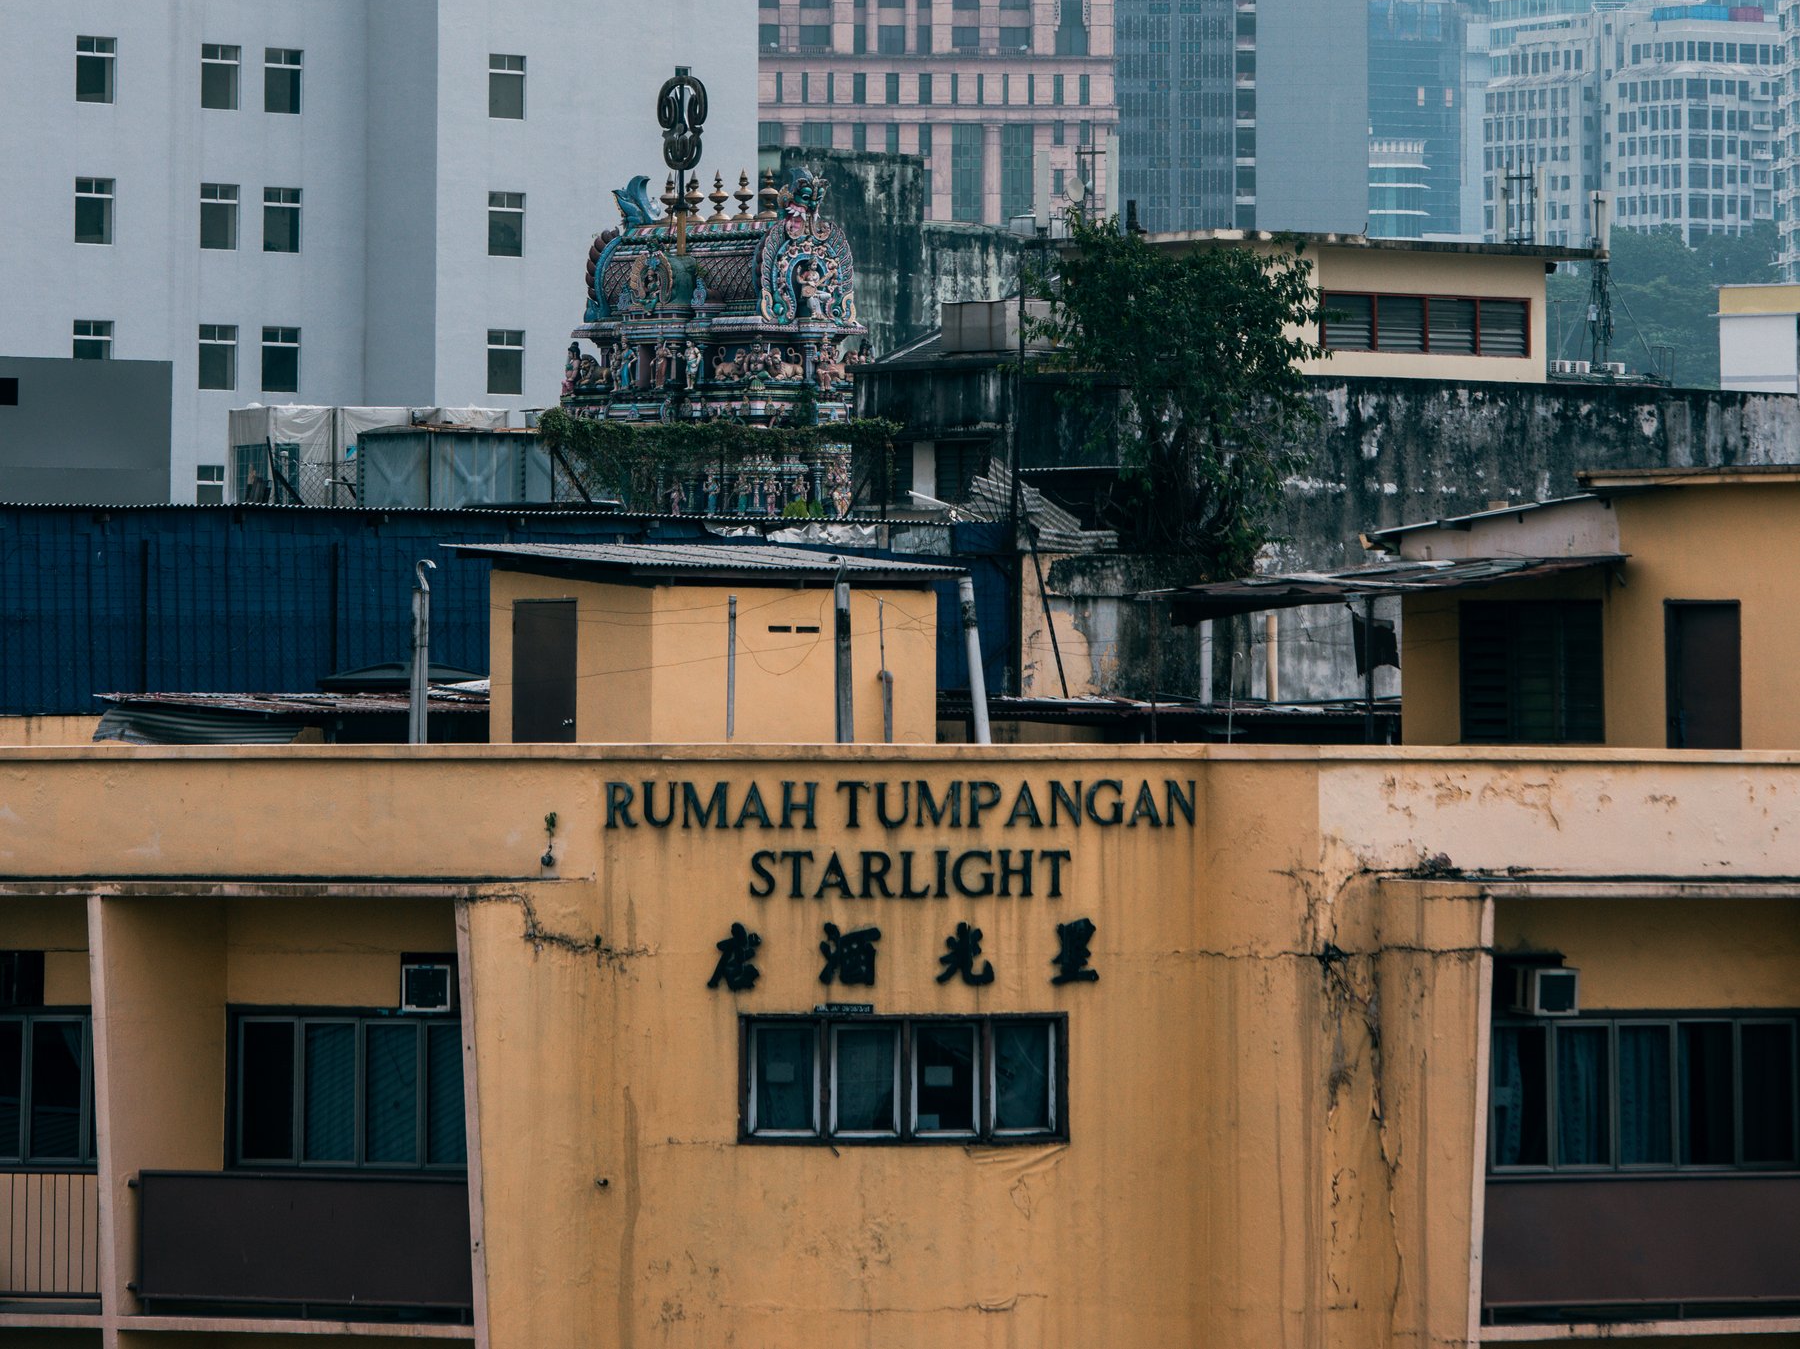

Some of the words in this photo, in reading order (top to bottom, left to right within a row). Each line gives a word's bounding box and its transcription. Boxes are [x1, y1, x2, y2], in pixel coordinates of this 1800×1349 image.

[604, 780, 818, 830] RUMAH
[836, 779, 1197, 828] TUMPANGAN
[749, 849, 1072, 899] STARLIGHT
